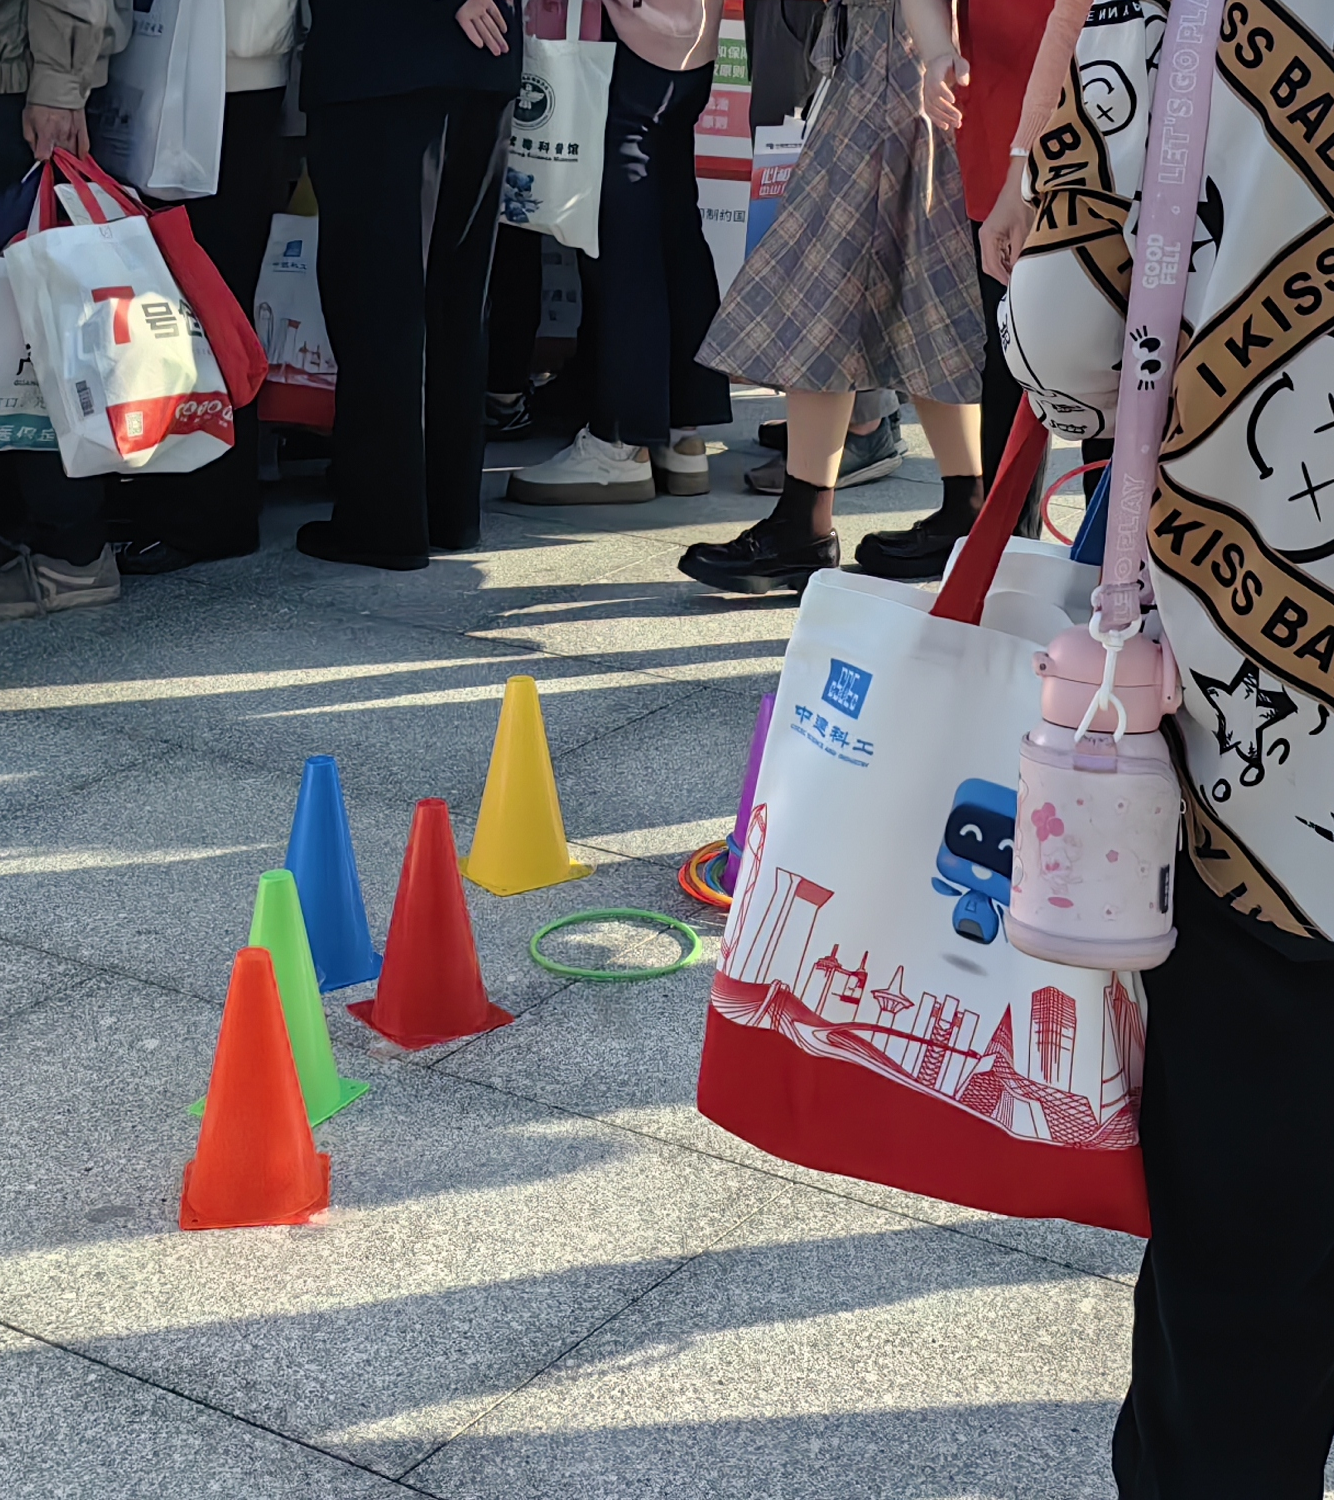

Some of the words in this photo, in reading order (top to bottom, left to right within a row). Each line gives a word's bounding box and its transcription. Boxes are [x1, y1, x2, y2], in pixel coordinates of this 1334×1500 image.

[1169, 41, 1201, 95] GO
[1159, 97, 1195, 184] LET'S
[1153, 503, 1264, 617] KISS
[795, 704, 874, 756] 中建科工
